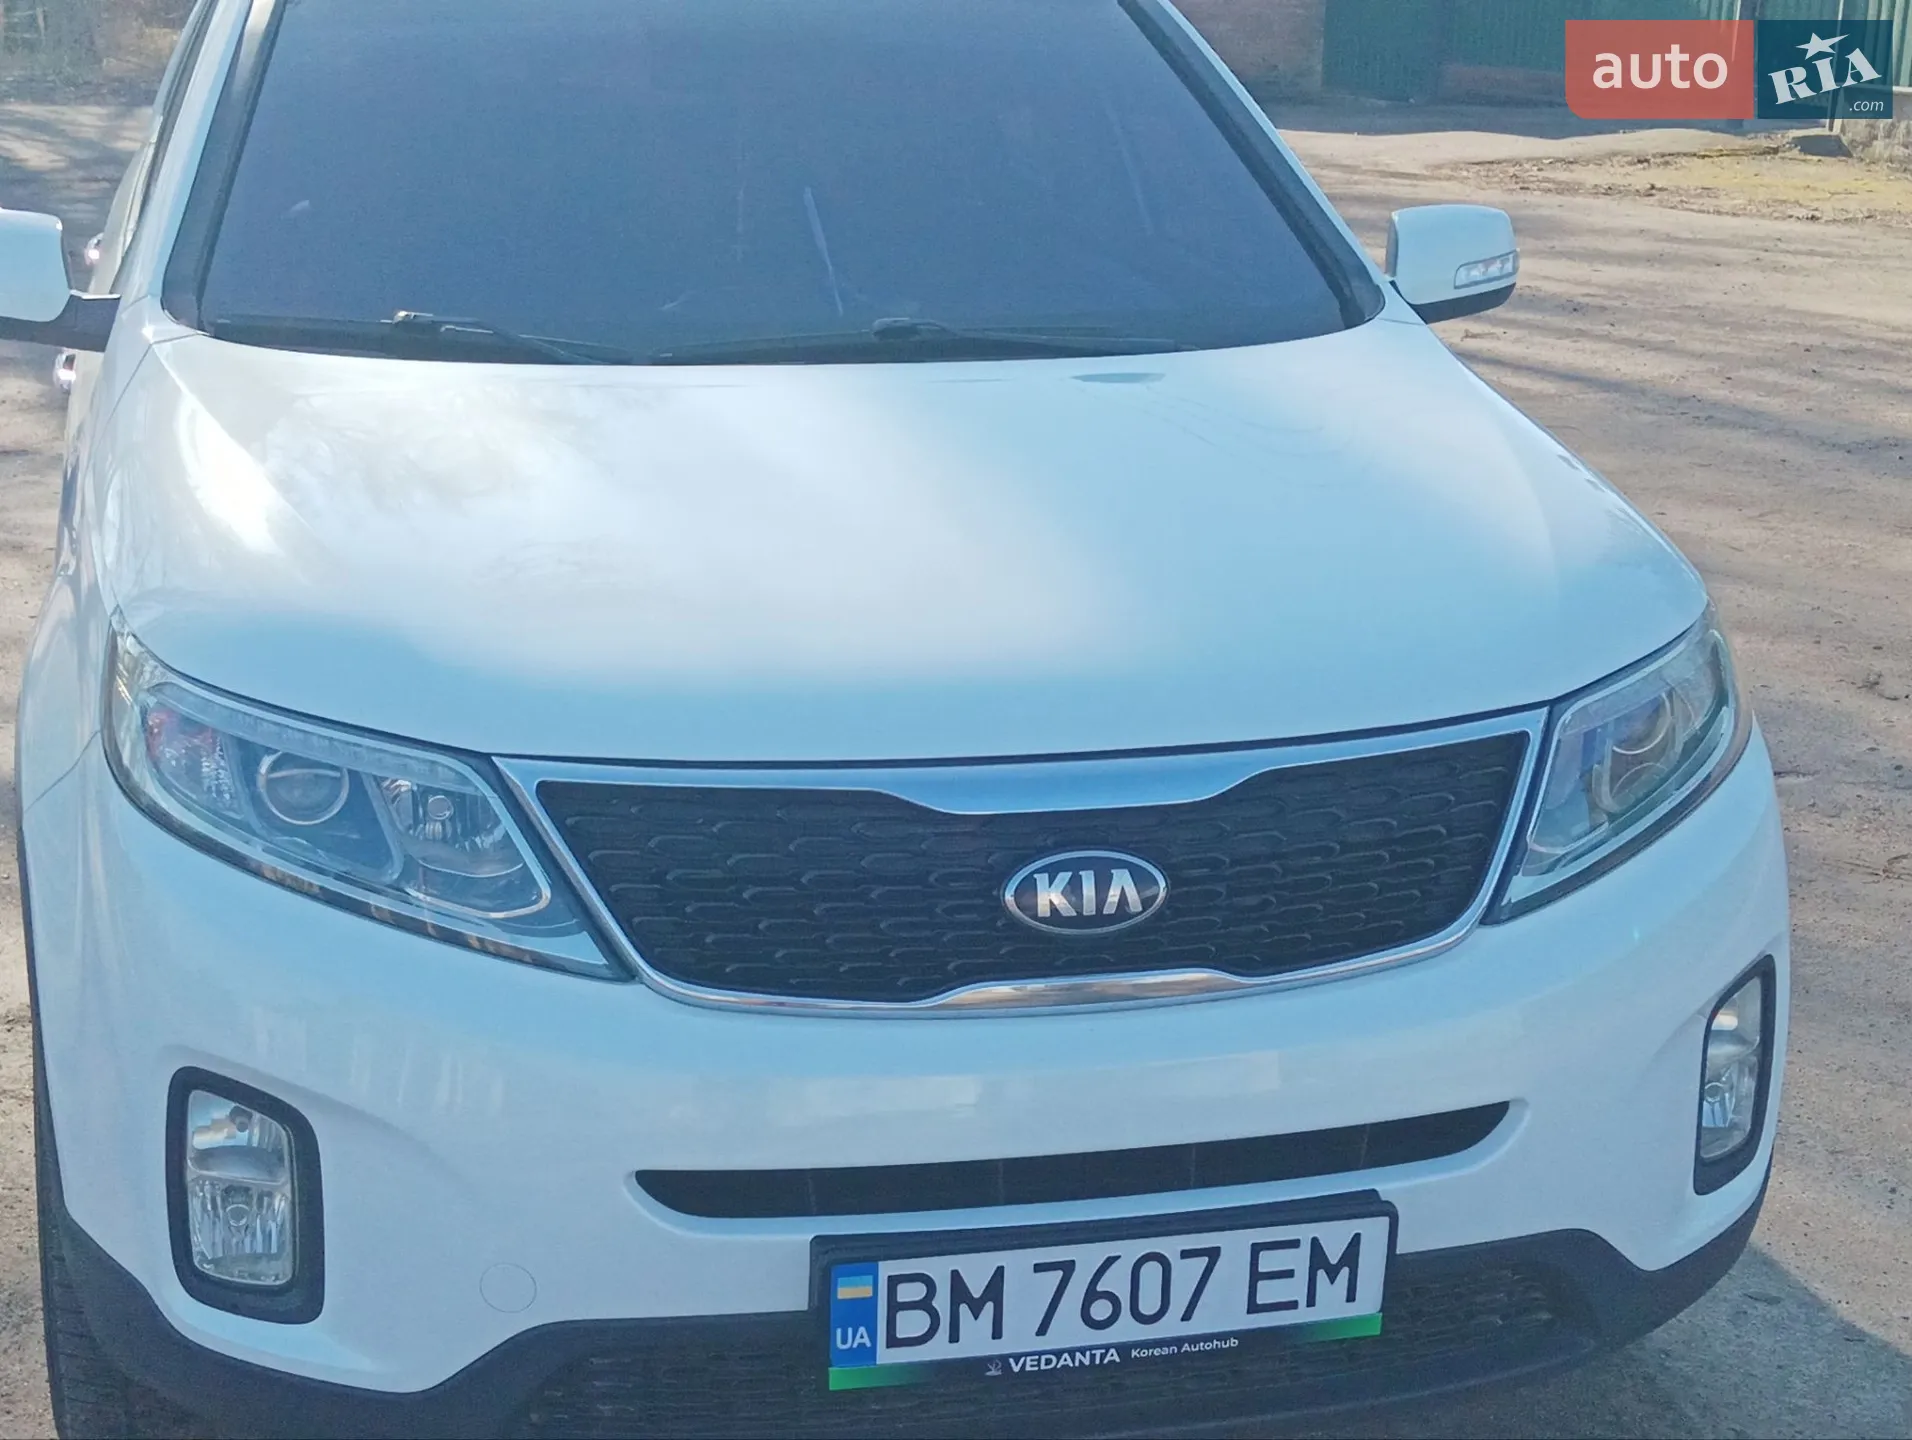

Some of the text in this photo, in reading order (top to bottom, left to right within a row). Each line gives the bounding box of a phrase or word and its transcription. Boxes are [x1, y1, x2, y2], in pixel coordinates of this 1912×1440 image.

[1033, 868, 1143, 917] KIA
[885, 1231, 1362, 1349] BM 7607 EM
[836, 1327, 871, 1349] UA
[1009, 1337, 1239, 1373] VEDANTA Korean Autohub
